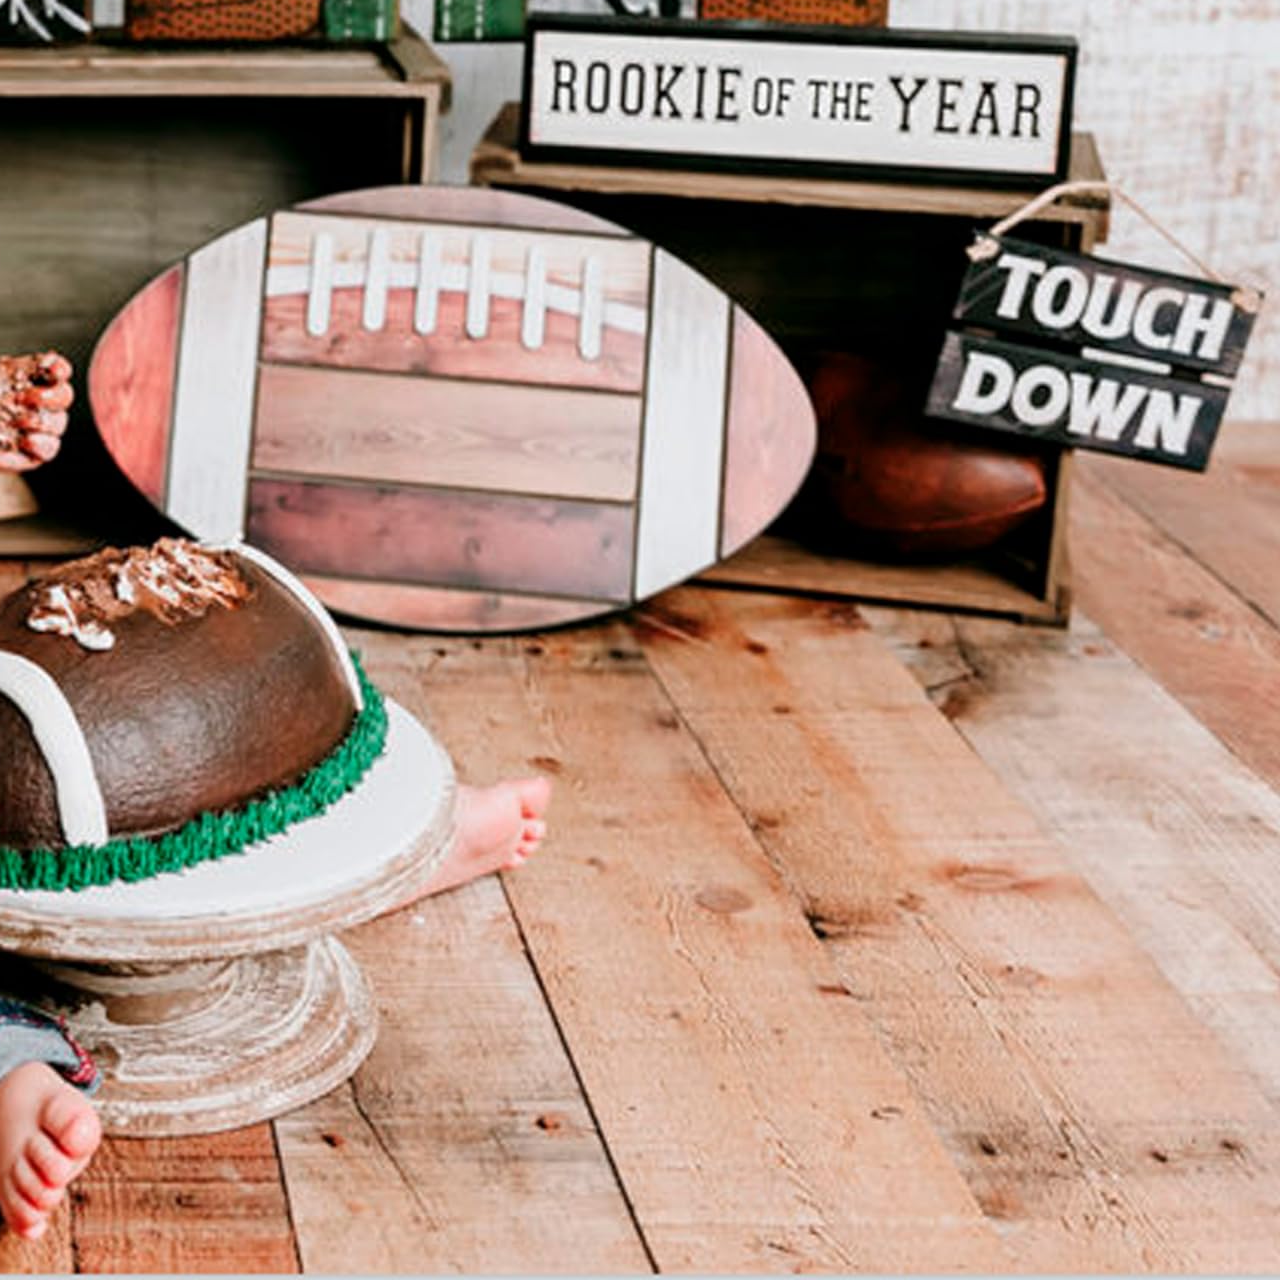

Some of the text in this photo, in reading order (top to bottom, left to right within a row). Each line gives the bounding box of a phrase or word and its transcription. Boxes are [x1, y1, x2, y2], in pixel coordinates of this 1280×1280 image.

[551, 59, 1044, 138] ROOKIE OF THE YEAR
[996, 253, 1234, 360] TOUCH
[952, 351, 1202, 455] DOWN
